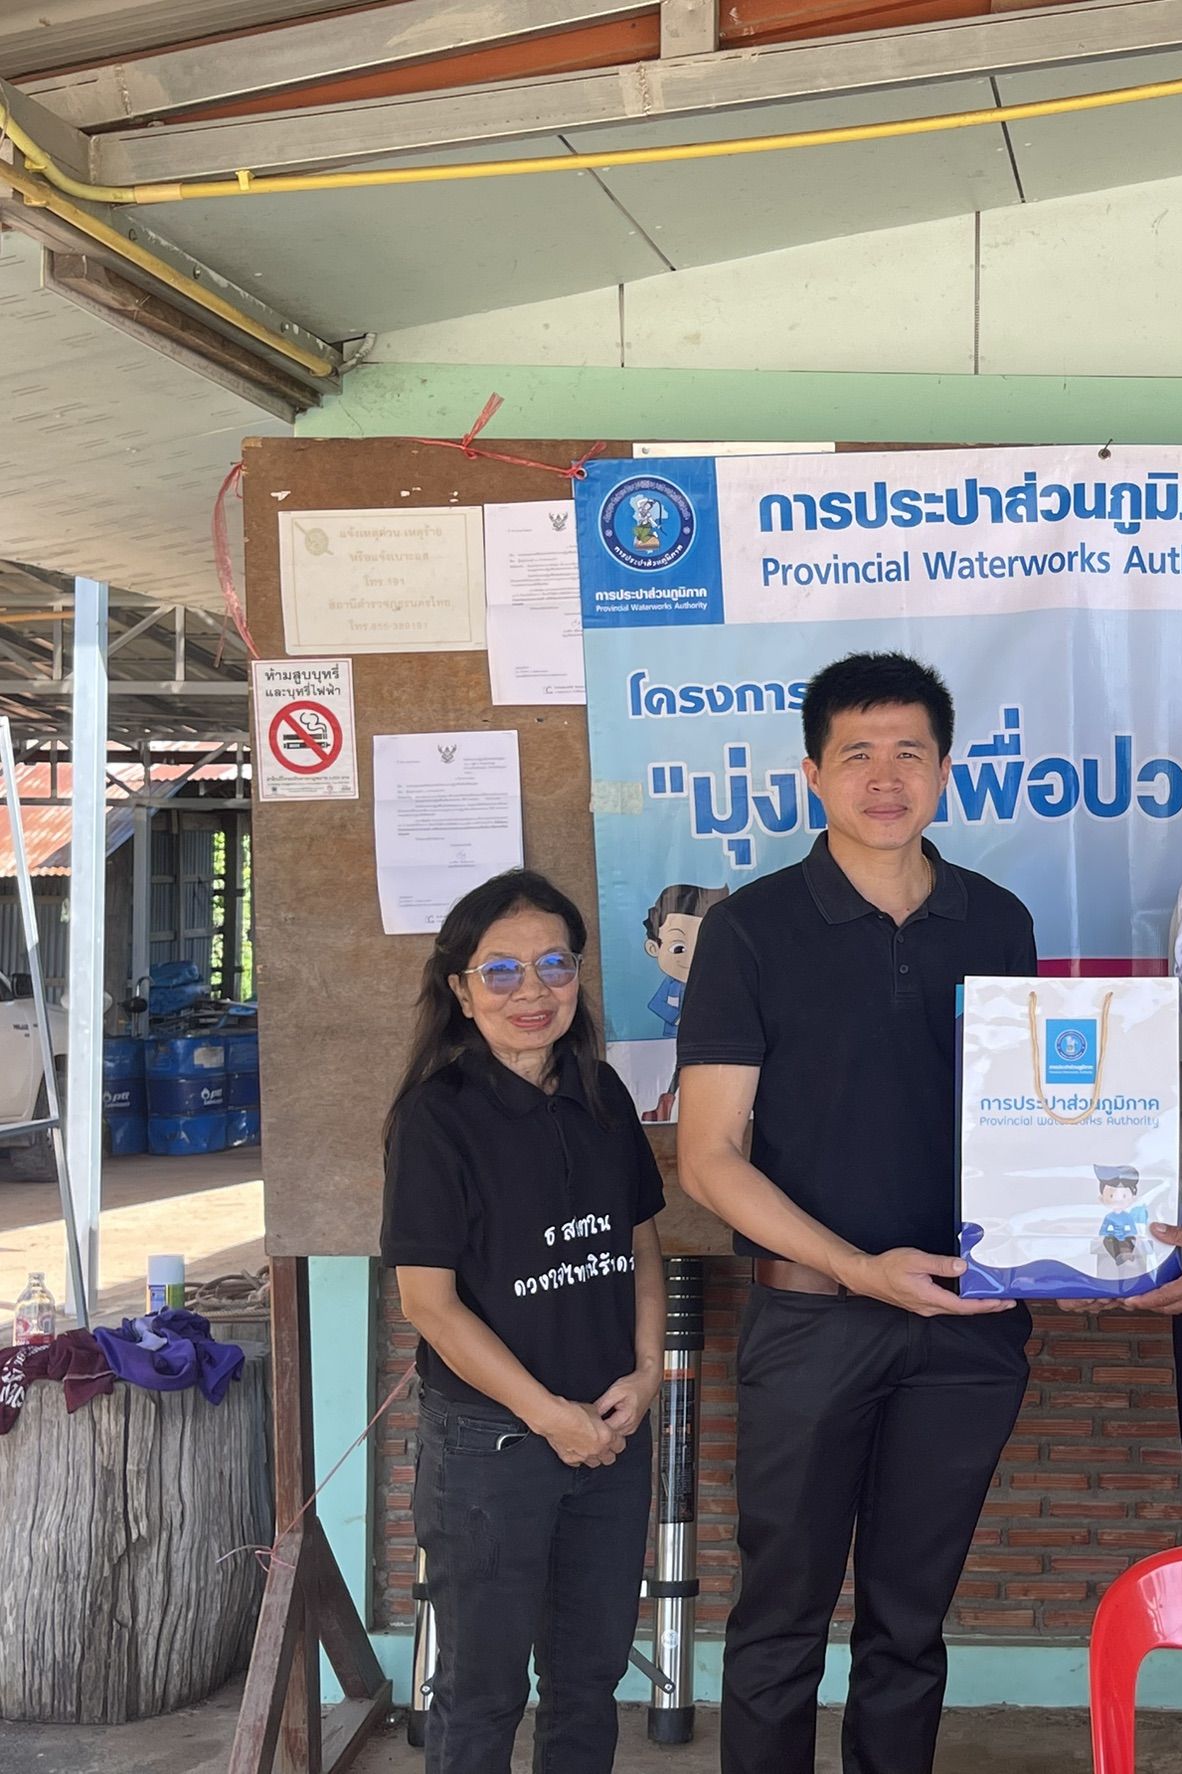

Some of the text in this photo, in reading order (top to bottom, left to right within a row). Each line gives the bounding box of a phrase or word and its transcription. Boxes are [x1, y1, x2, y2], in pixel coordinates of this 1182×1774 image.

[761, 552, 910, 586] Provincial
[922, 543, 1111, 581] Waterworks
[595, 586, 708, 602] การประปาส่วนภูมิภาค
[596, 602, 708, 613] Provincial Waterworks Authority
[264, 664, 340, 684] ห้ามสูบบุหรี่
[265, 683, 341, 699] และบุหรี่ไฟฟ้า
[979, 1116, 1033, 1126] Provincial
[1107, 1115, 1160, 1128] Authority
